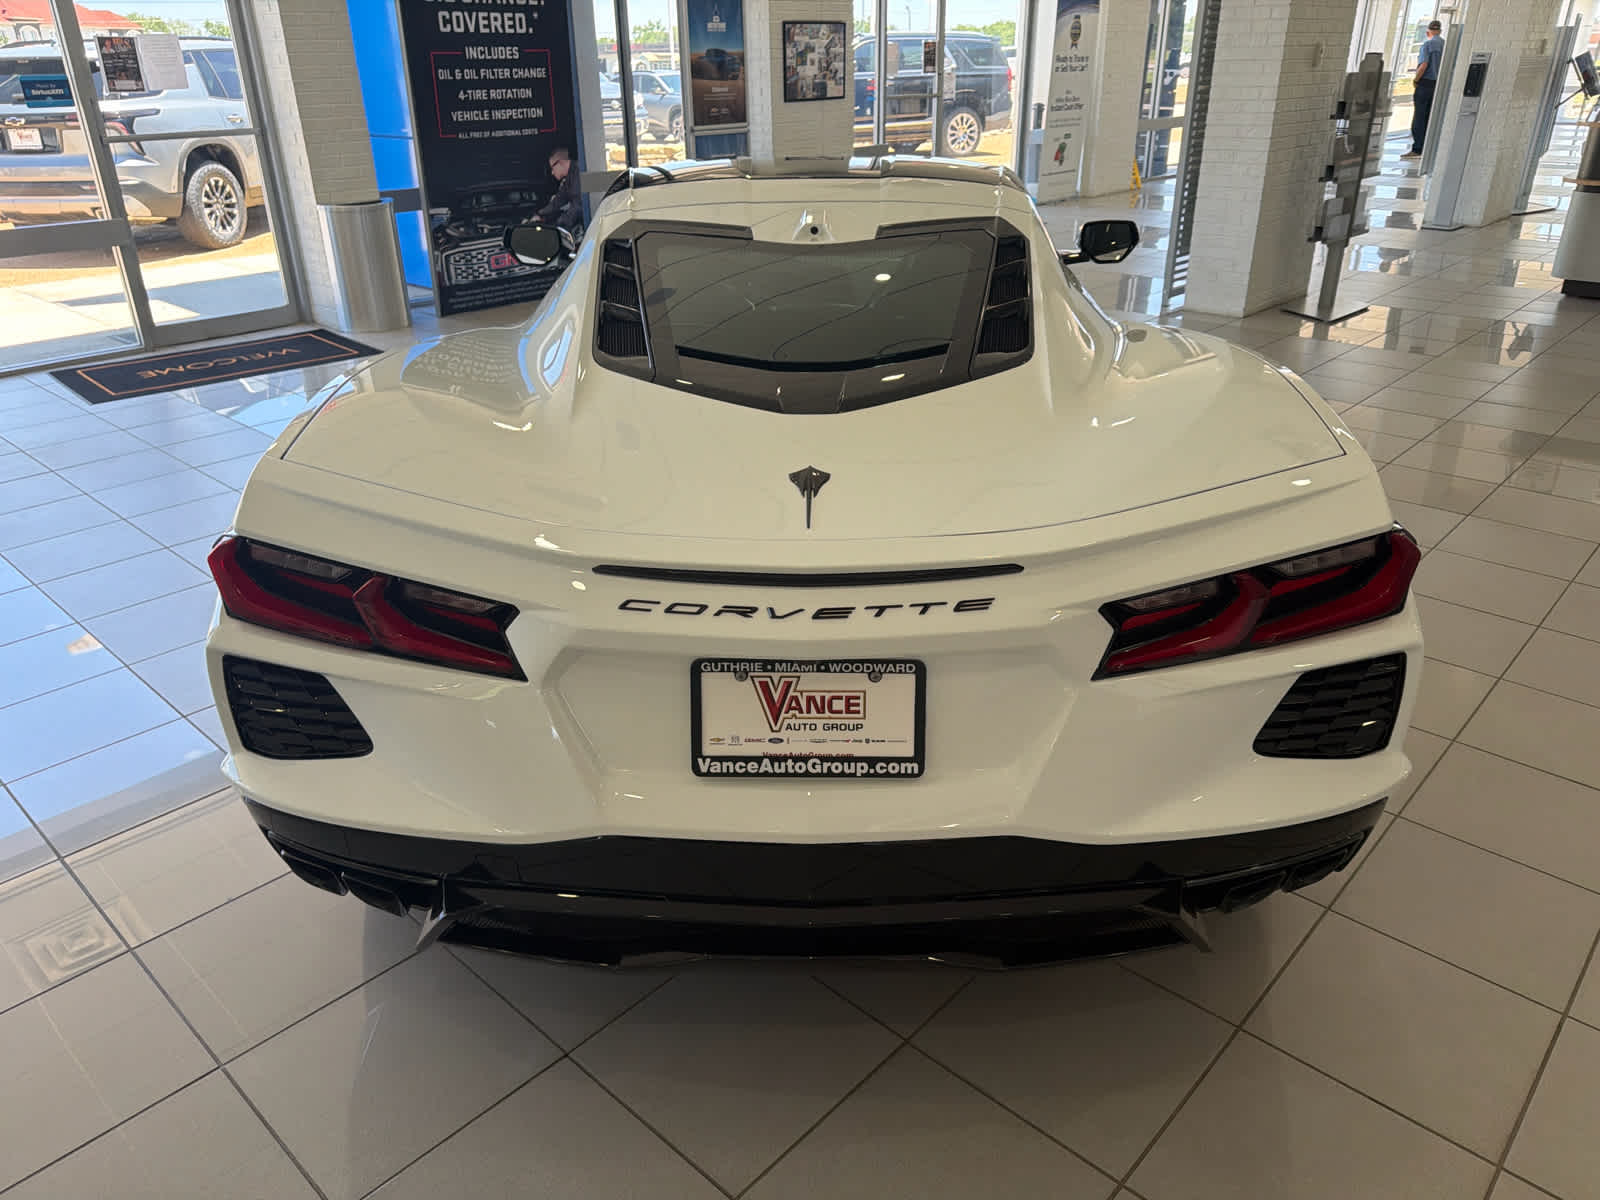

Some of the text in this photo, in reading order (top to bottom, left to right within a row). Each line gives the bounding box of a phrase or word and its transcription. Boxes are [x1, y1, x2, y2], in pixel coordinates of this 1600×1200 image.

[465, 46, 519, 59] INCLUDES
[438, 67, 547, 80] OIL & OIL FILTER CHANGE
[458, 88, 533, 101] 4-TIRE ROTATION
[451, 107, 543, 122] VEHICLE INSPECTION
[136, 348, 301, 379] WELCOME
[617, 597, 996, 620] CORVETTE
[701, 662, 763, 673] GUTHRIE
[829, 662, 916, 674] WOODWARD
[755, 678, 862, 729] VANCE
[785, 722, 864, 732] AUTO GROUP
[697, 757, 919, 776] VanceAutoGroup.com
